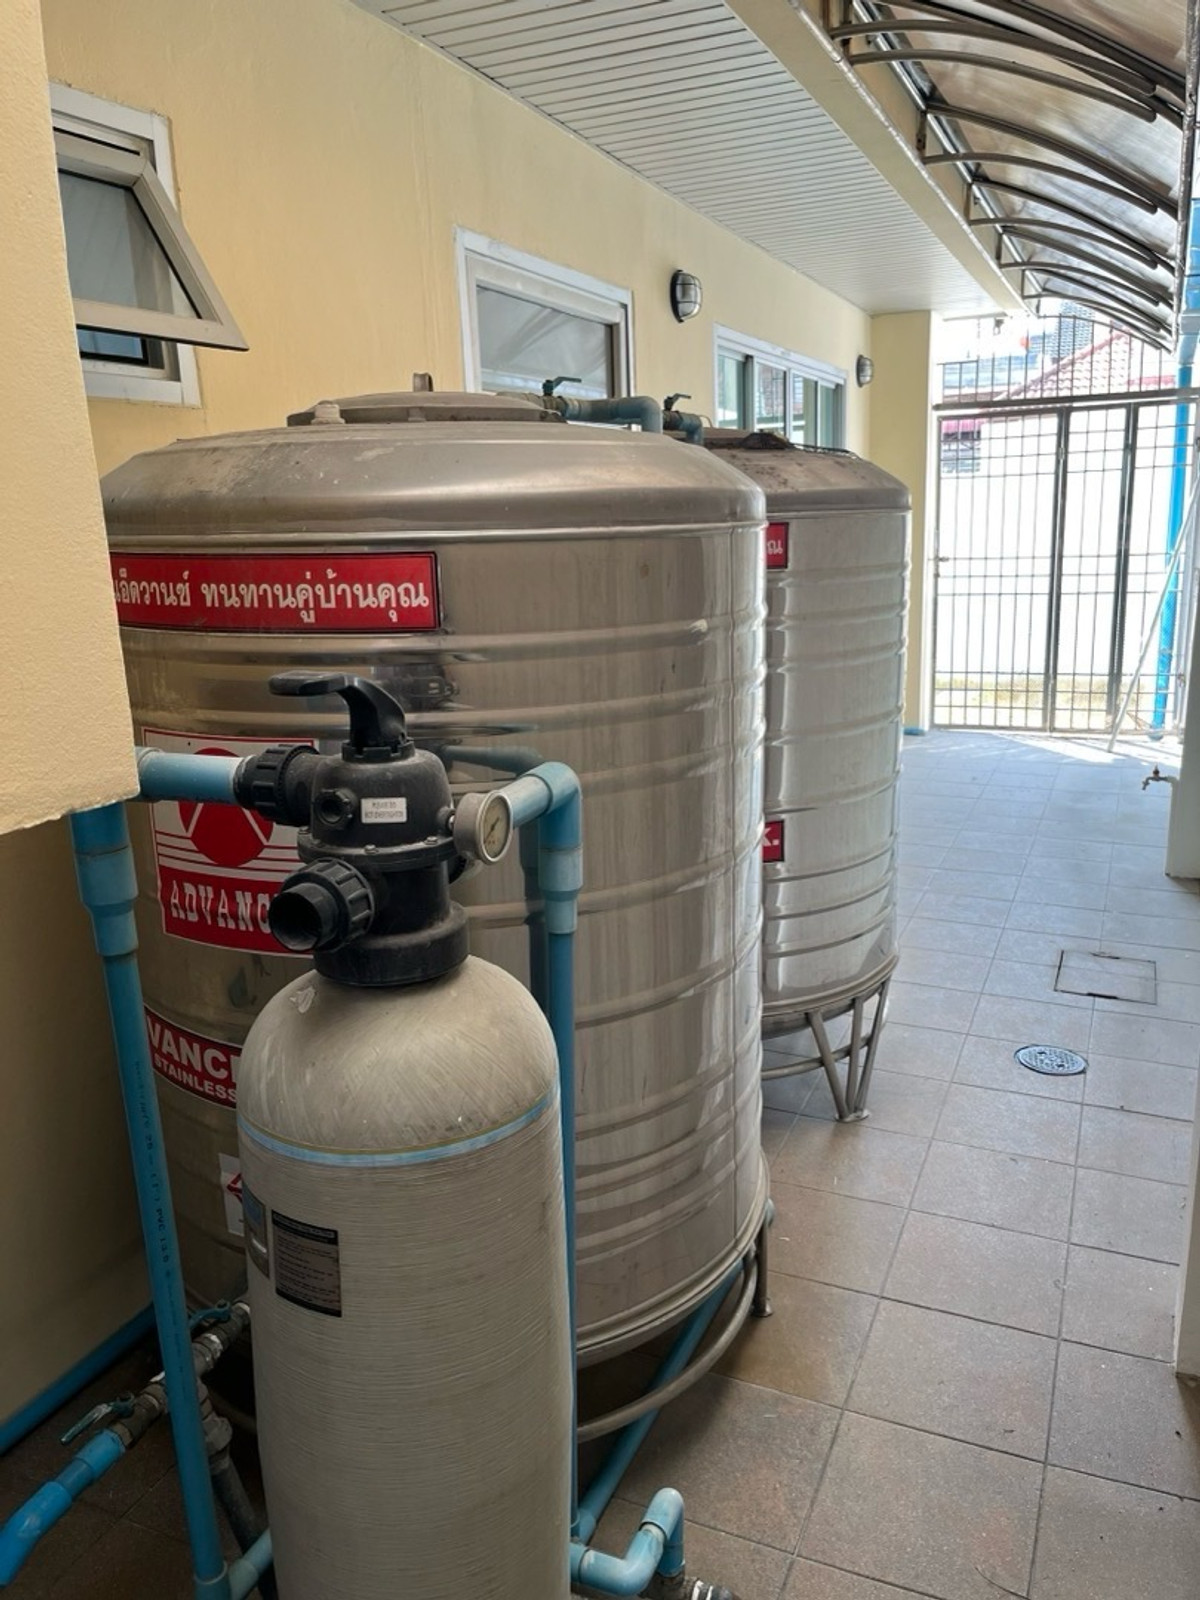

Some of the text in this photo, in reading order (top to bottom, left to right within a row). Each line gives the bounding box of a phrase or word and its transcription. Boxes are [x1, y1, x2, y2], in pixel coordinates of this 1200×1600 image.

[200, 568, 429, 623] ทนทานคู่บ้านคุณ
